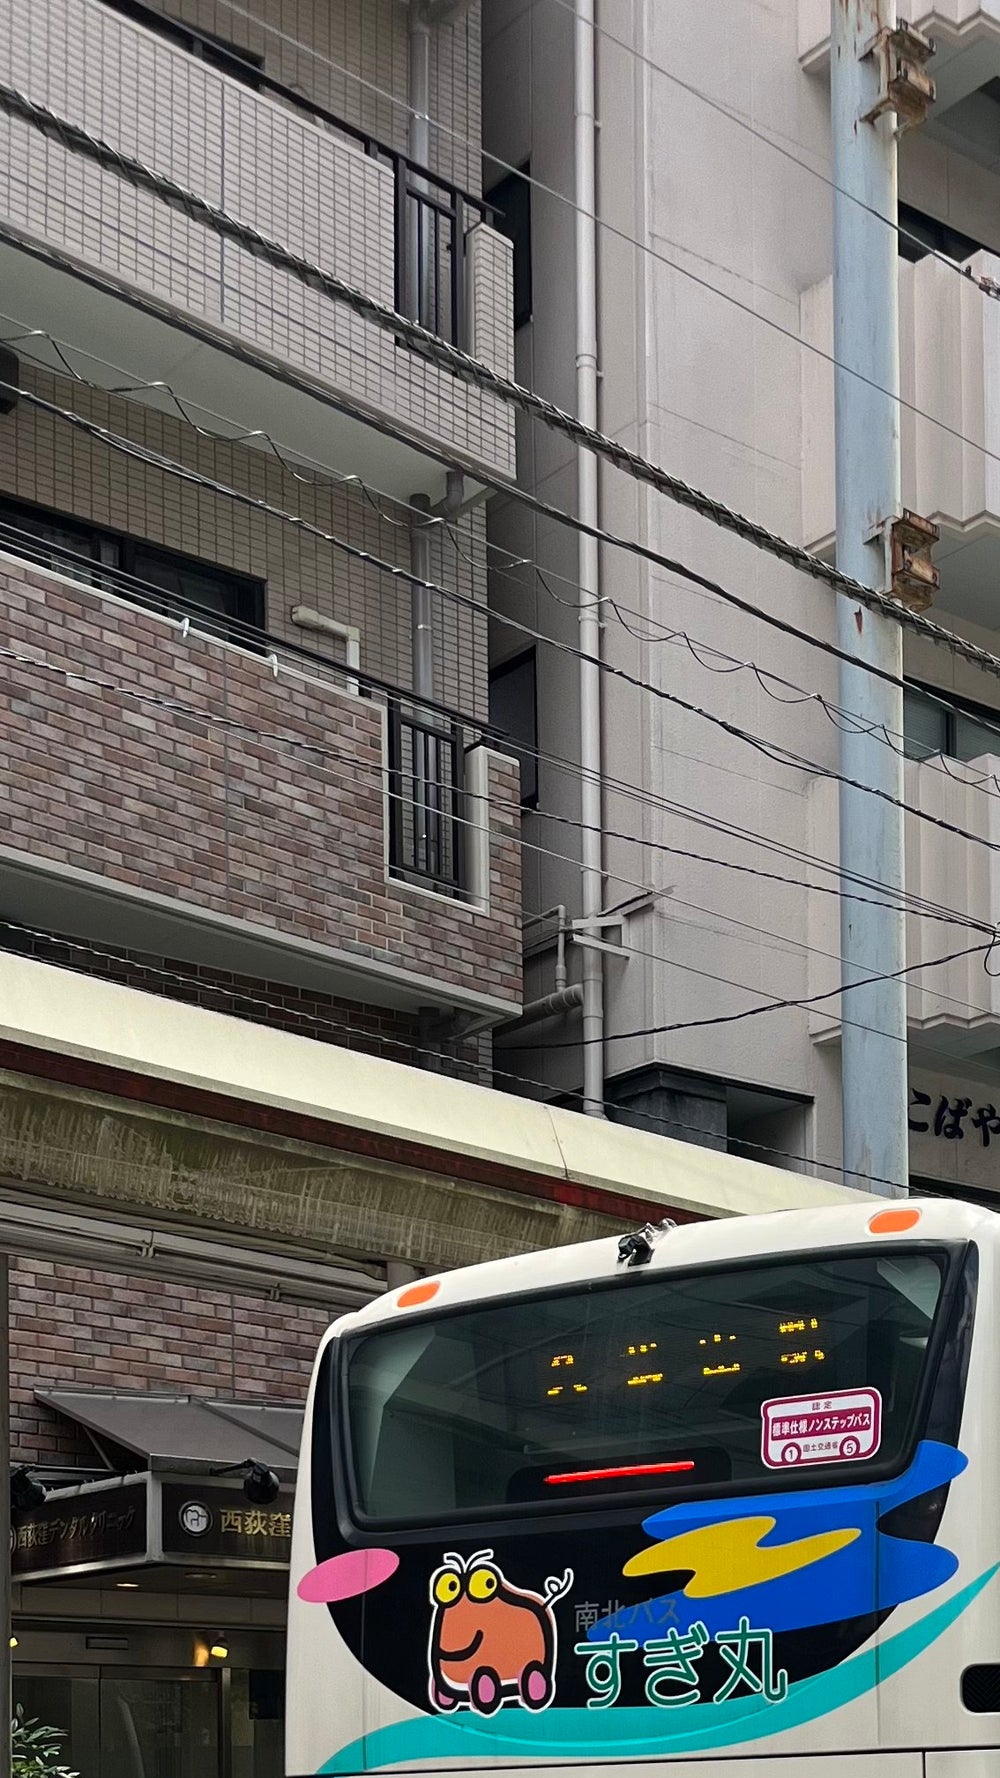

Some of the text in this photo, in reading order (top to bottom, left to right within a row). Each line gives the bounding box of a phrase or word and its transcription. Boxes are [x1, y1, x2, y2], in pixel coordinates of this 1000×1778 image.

[772, 1413, 871, 1437] 標準仕様ノンステップバス
[219, 1508, 292, 1538] 西荻窪
[574, 1598, 681, 1633] 南北バス
[574, 1616, 788, 1710] すぎ丸
